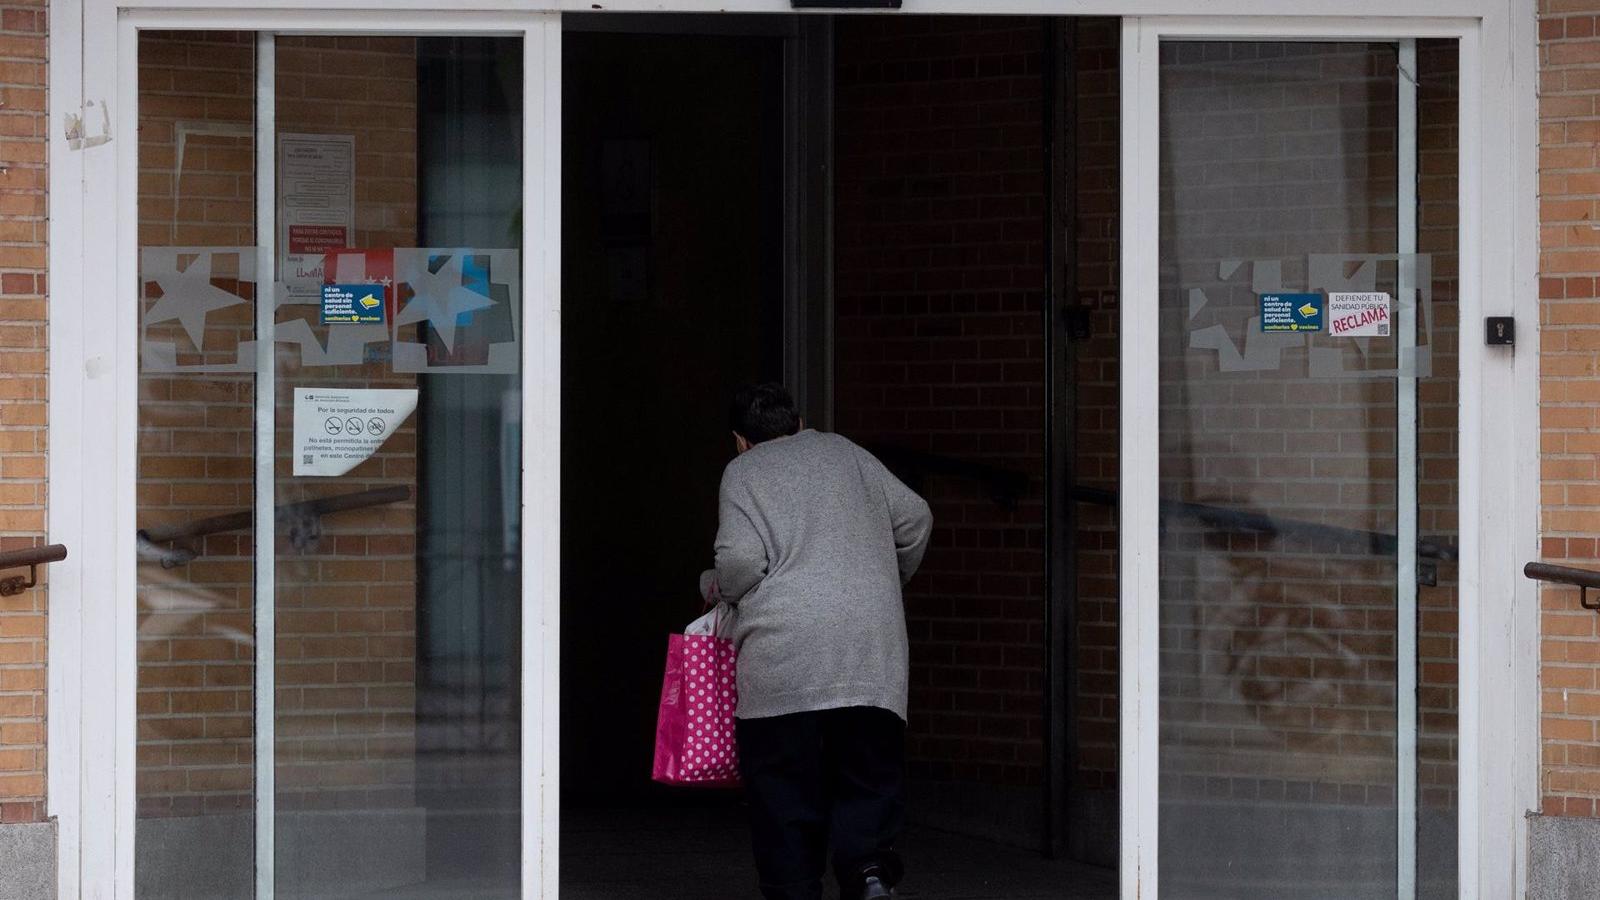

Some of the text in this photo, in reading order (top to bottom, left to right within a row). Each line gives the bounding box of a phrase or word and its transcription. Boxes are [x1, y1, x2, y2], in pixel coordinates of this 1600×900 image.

[1335, 294, 1372, 302] DEFIENDE
[1333, 307, 1388, 334] RECLAMA
[336, 407, 367, 415] seguridad
[333, 437, 363, 446] permitida
